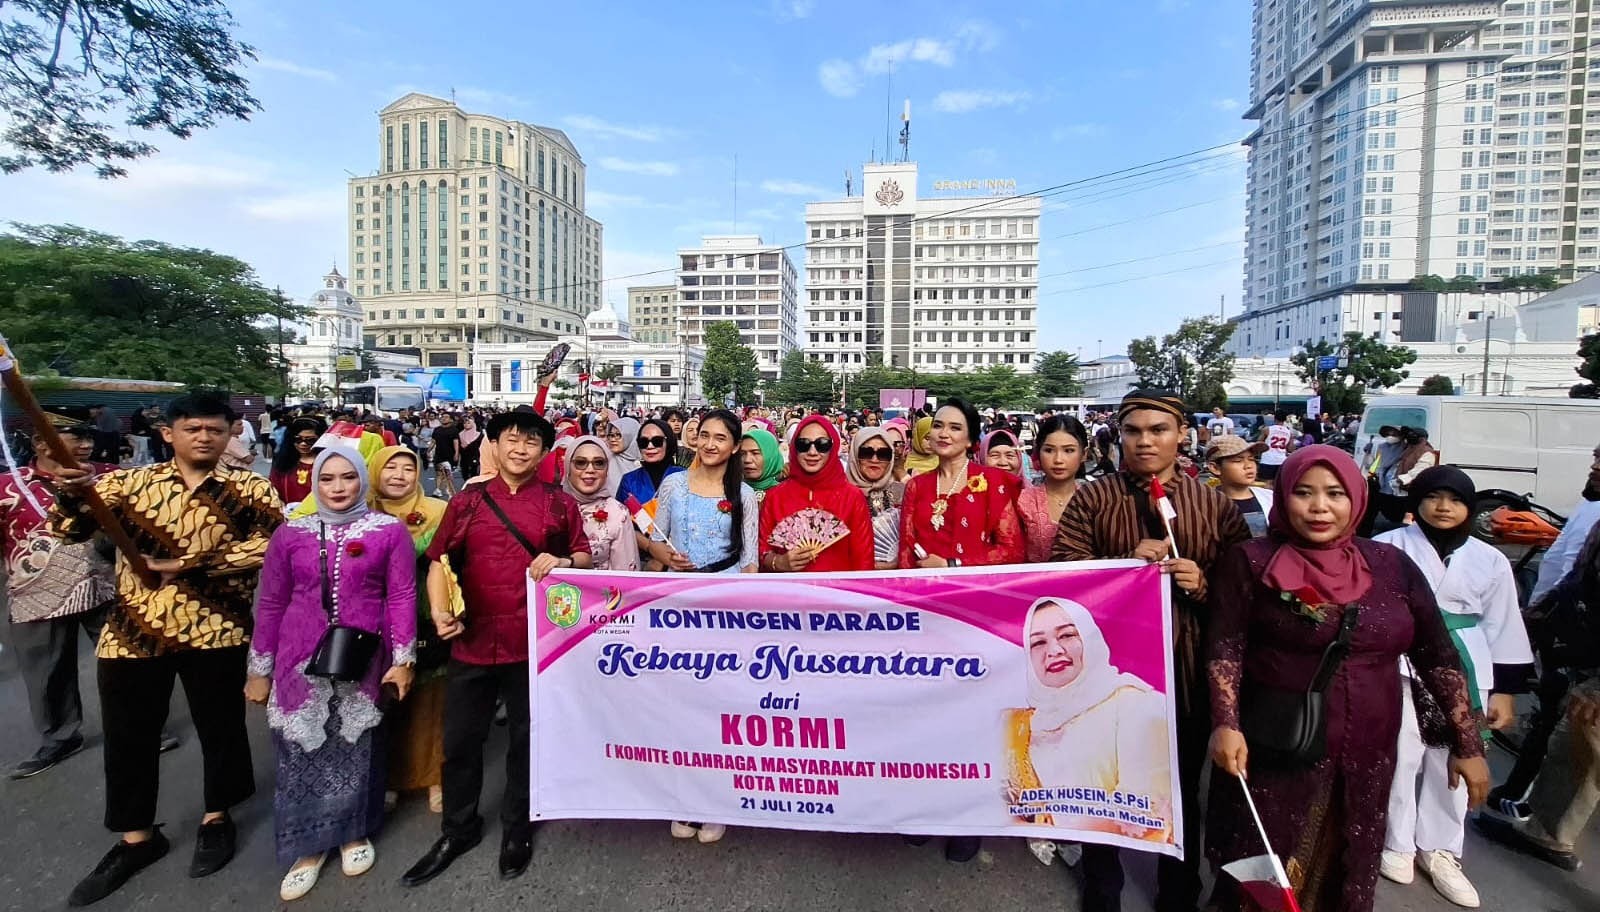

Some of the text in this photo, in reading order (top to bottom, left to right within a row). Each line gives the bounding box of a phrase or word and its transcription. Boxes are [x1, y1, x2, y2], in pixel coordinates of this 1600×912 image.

[1270, 436, 1287, 450] 23
[589, 614, 635, 625] KORMI
[650, 609, 920, 631] KONTINGEN PARADE
[598, 643, 986, 681] Kebaya Nusantara
[759, 691, 800, 710] dari
[720, 713, 846, 750] KORMI
[615, 744, 669, 765] KOMITE
[672, 750, 757, 772] OLAHRAGA
[761, 756, 875, 778] MASYARAKAT
[881, 763, 979, 779] INDONESIA
[733, 774, 839, 796] KOTA MEDAN
[740, 797, 835, 814] 21 JULI 2024
[1021, 788, 1149, 810] ADEK HUSEIN, S.Psi
[1009, 804, 1162, 827] Ketua KORMI Kota Medan
